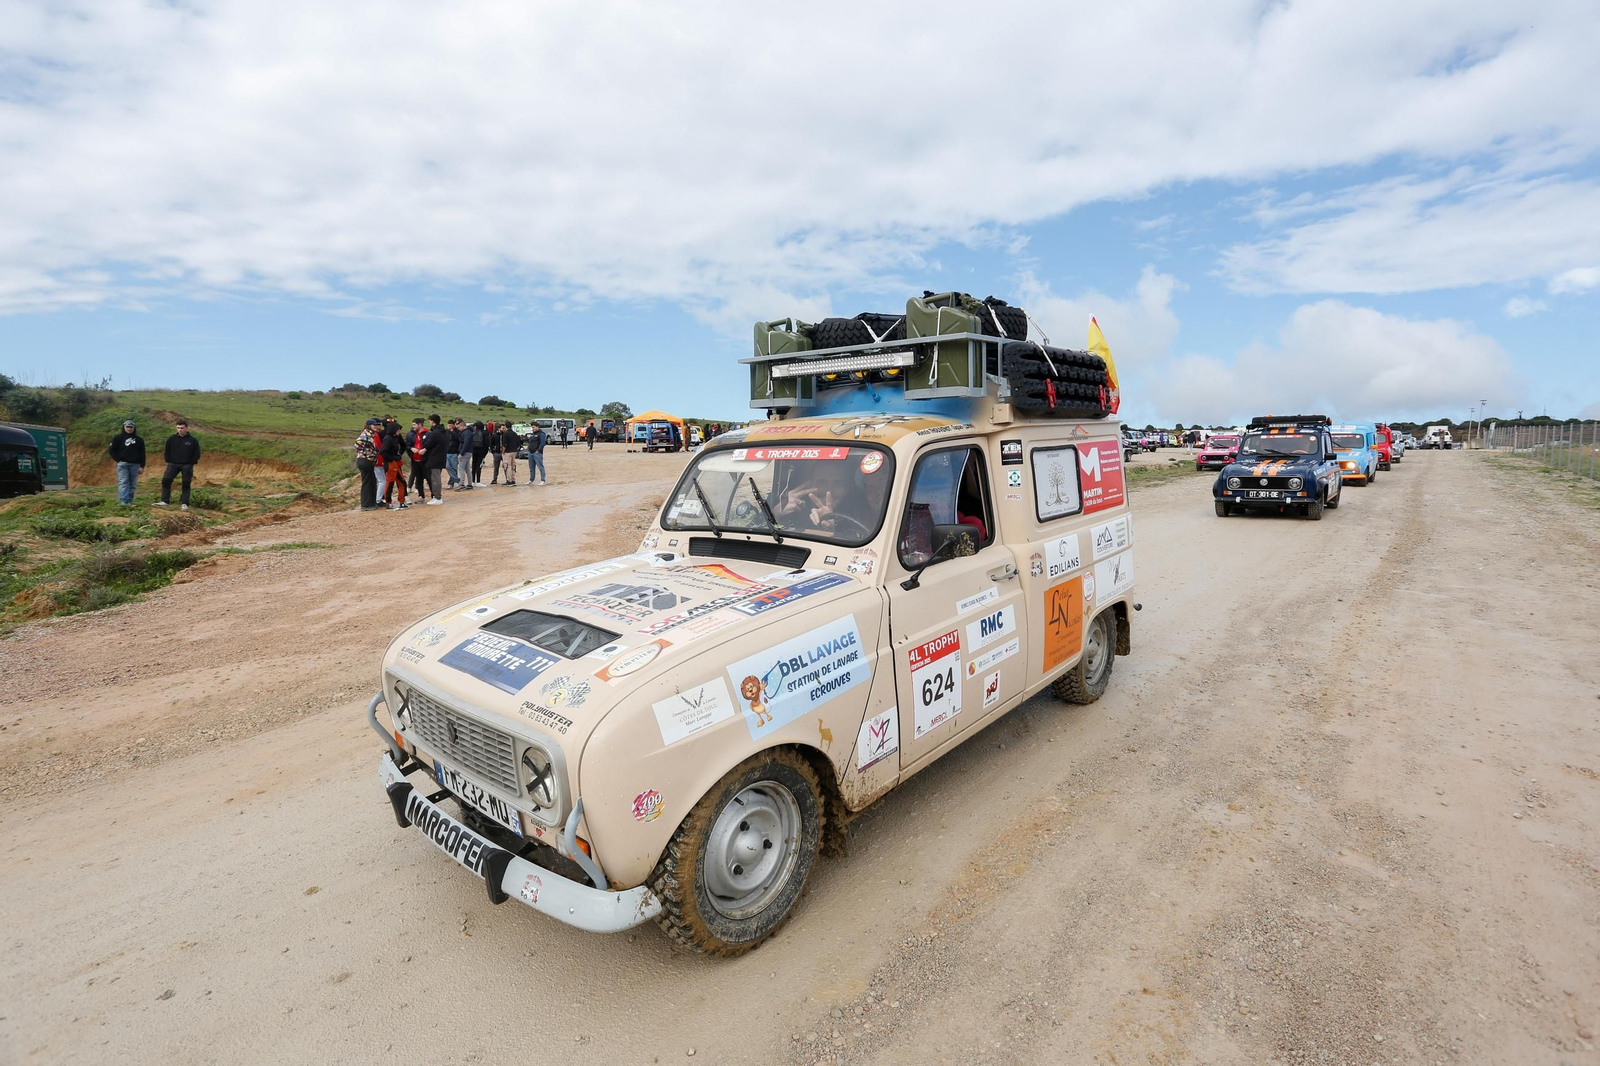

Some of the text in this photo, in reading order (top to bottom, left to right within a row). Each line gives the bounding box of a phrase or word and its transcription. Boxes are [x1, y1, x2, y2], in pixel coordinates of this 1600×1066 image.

[754, 450, 764, 458] 4L
[767, 449, 800, 458] TROPHY
[801, 449, 820, 458] 2025
[1083, 487, 1103, 499] MARTIN
[1050, 556, 1080, 577] EDILIANS
[756, 592, 802, 611] LOCATION
[980, 610, 1004, 638] RMC
[612, 647, 657, 673] TEMPLIERS
[778, 631, 856, 678] DBL LAVAGE
[909, 631, 958, 663] 4L TROPHY
[787, 650, 859, 693] STATION DE LAVAGE
[810, 671, 851, 701] ECROUVES
[922, 666, 955, 707] 624
[550, 721, 558, 730] 47
[558, 725, 567, 735] 40
